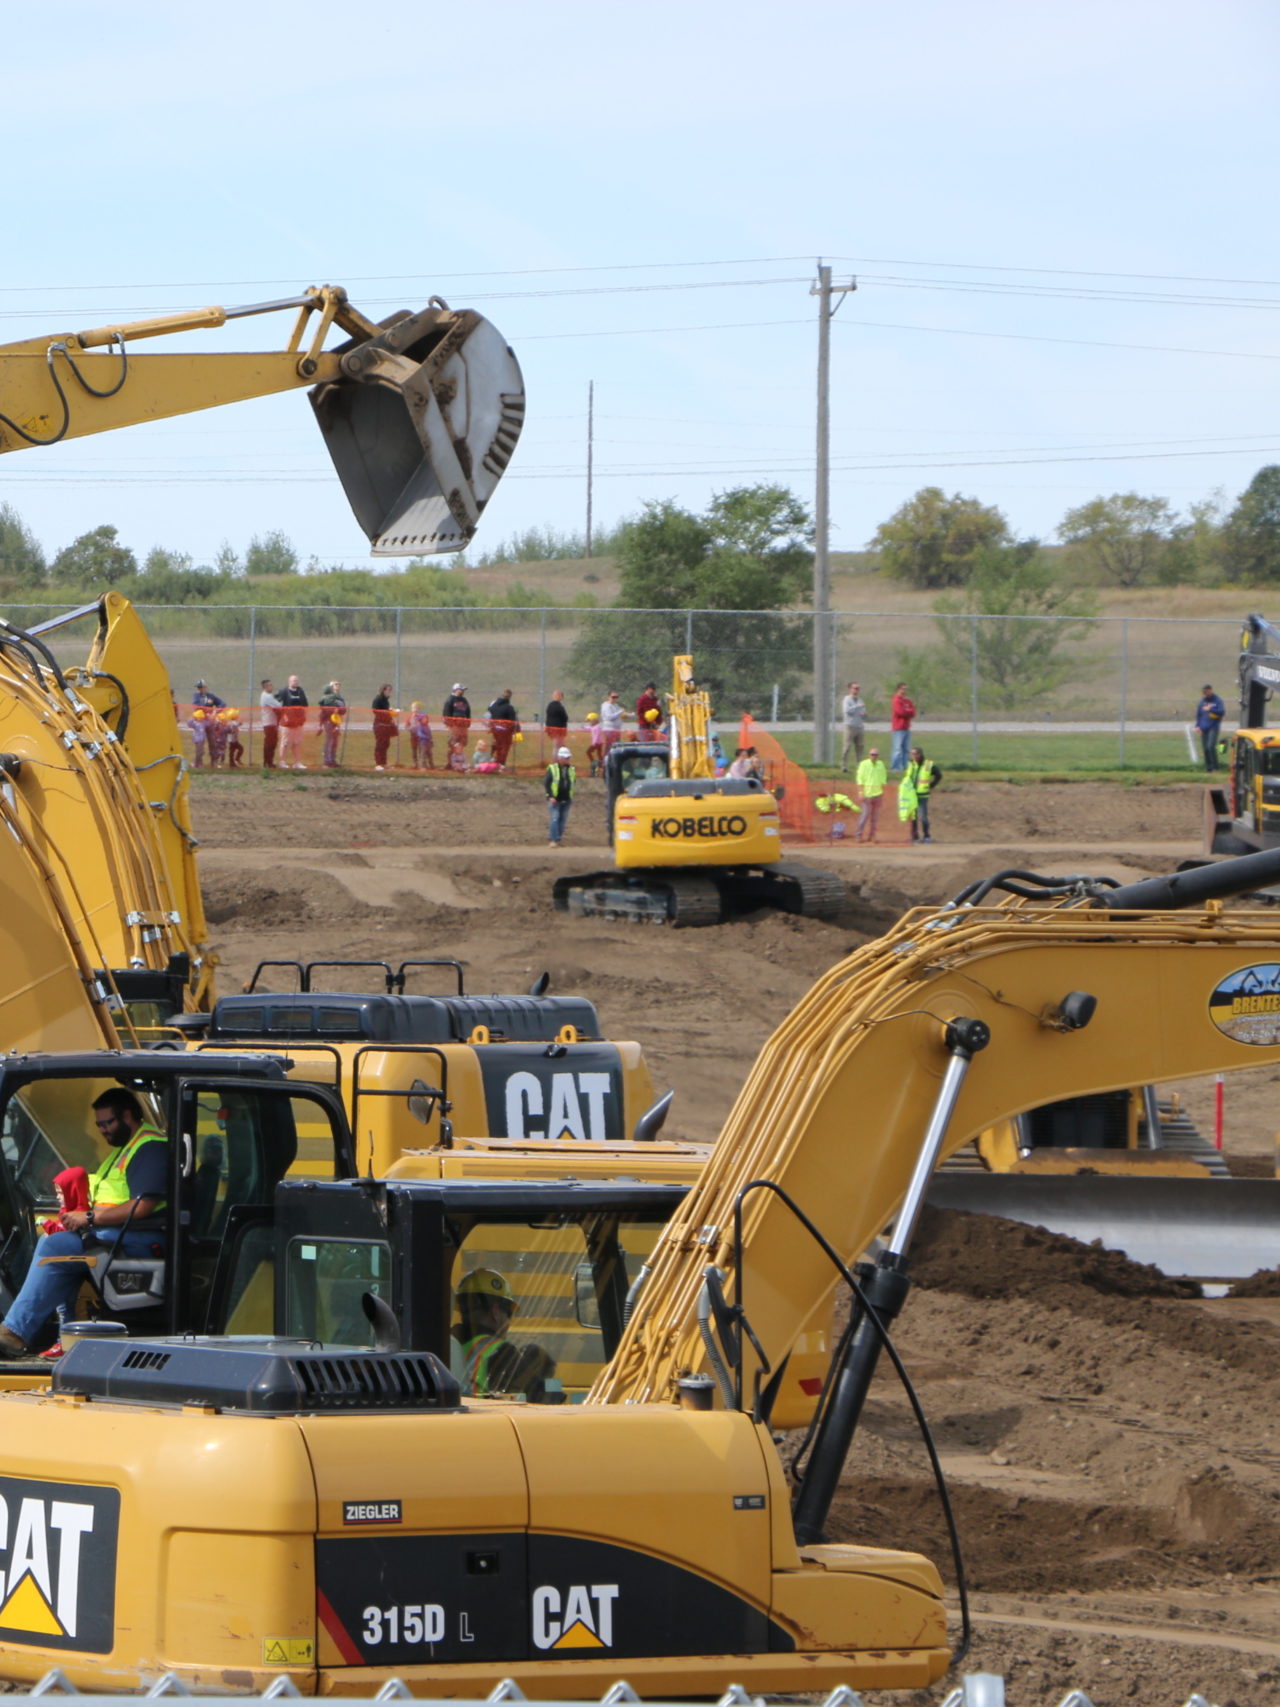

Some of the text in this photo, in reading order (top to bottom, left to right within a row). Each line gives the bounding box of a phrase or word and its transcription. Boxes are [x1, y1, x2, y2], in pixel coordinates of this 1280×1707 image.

[651, 816, 747, 838] KOBELCO
[505, 1071, 611, 1139] CAT
[346, 1504, 399, 1520] ZIEGLER
[363, 1604, 475, 1645] 315D L
[533, 1584, 619, 1650] CAT
